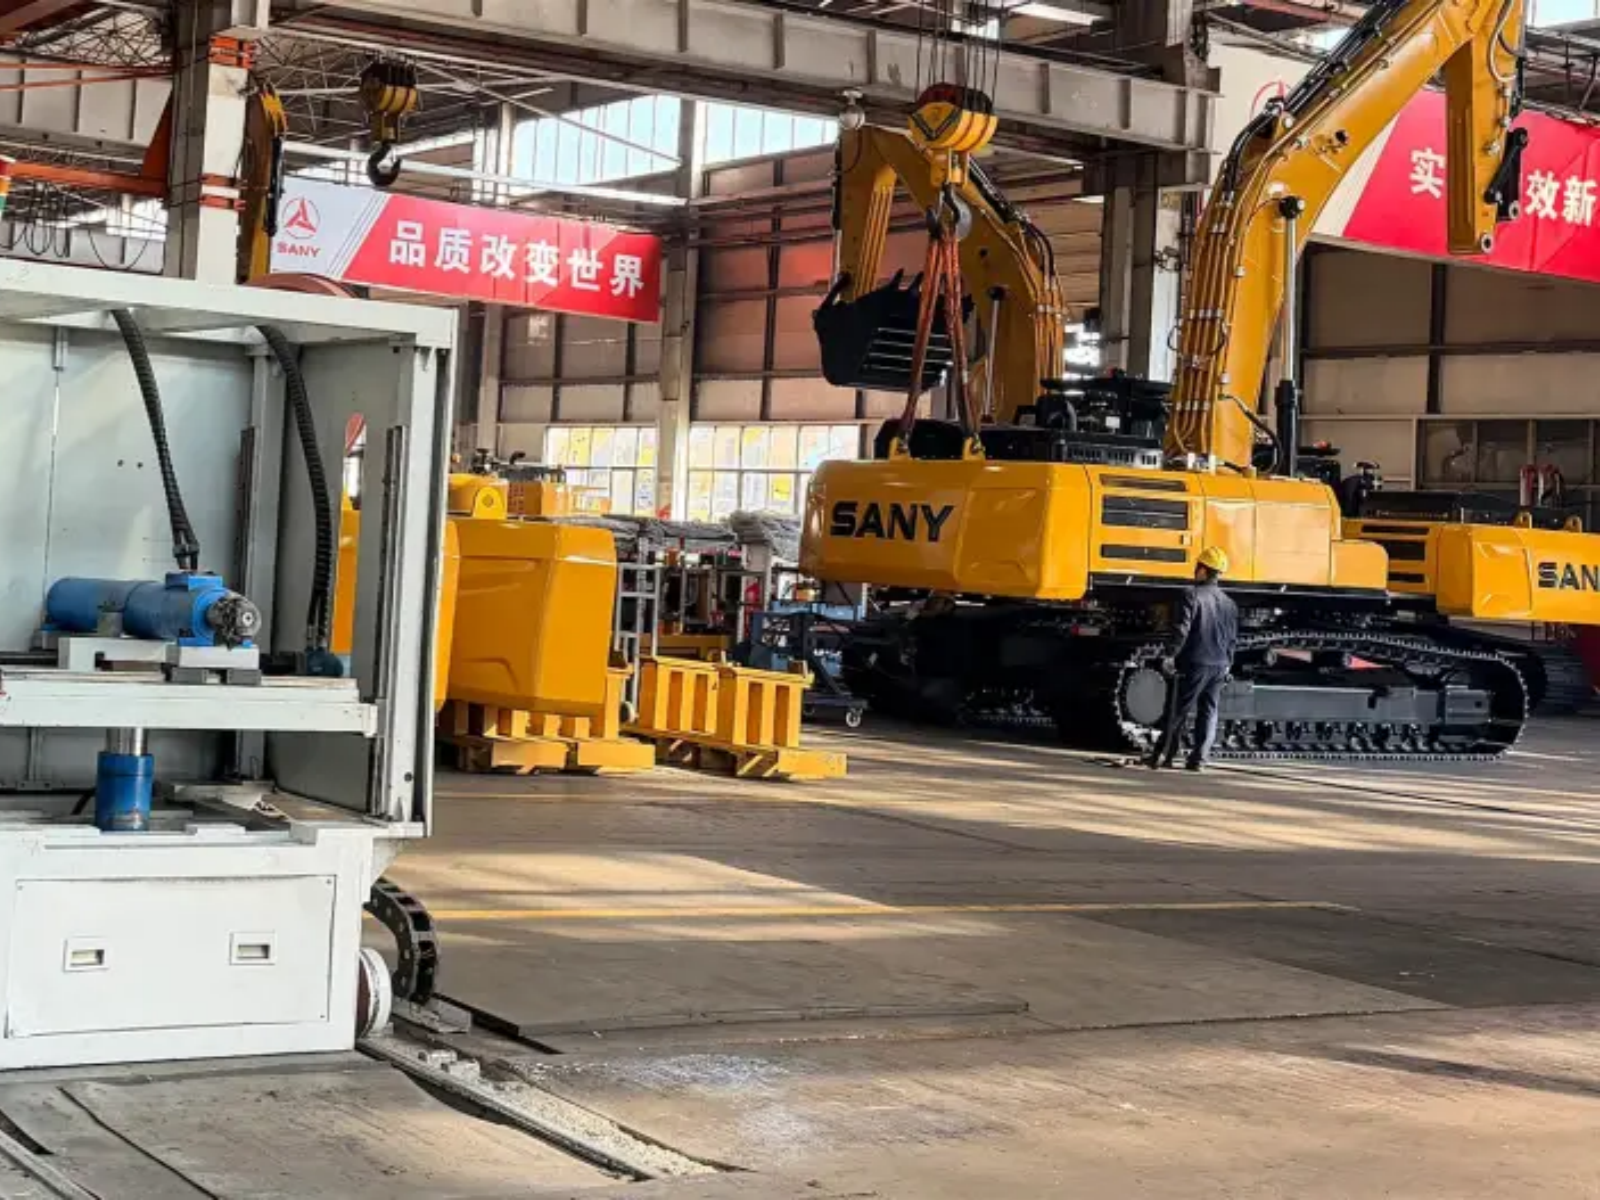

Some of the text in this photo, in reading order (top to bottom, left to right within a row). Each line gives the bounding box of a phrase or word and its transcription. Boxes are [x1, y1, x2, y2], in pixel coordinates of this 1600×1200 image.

[277, 242, 321, 258] SANY
[389, 219, 643, 298] 品质改变世界
[830, 501, 953, 543] SANY
